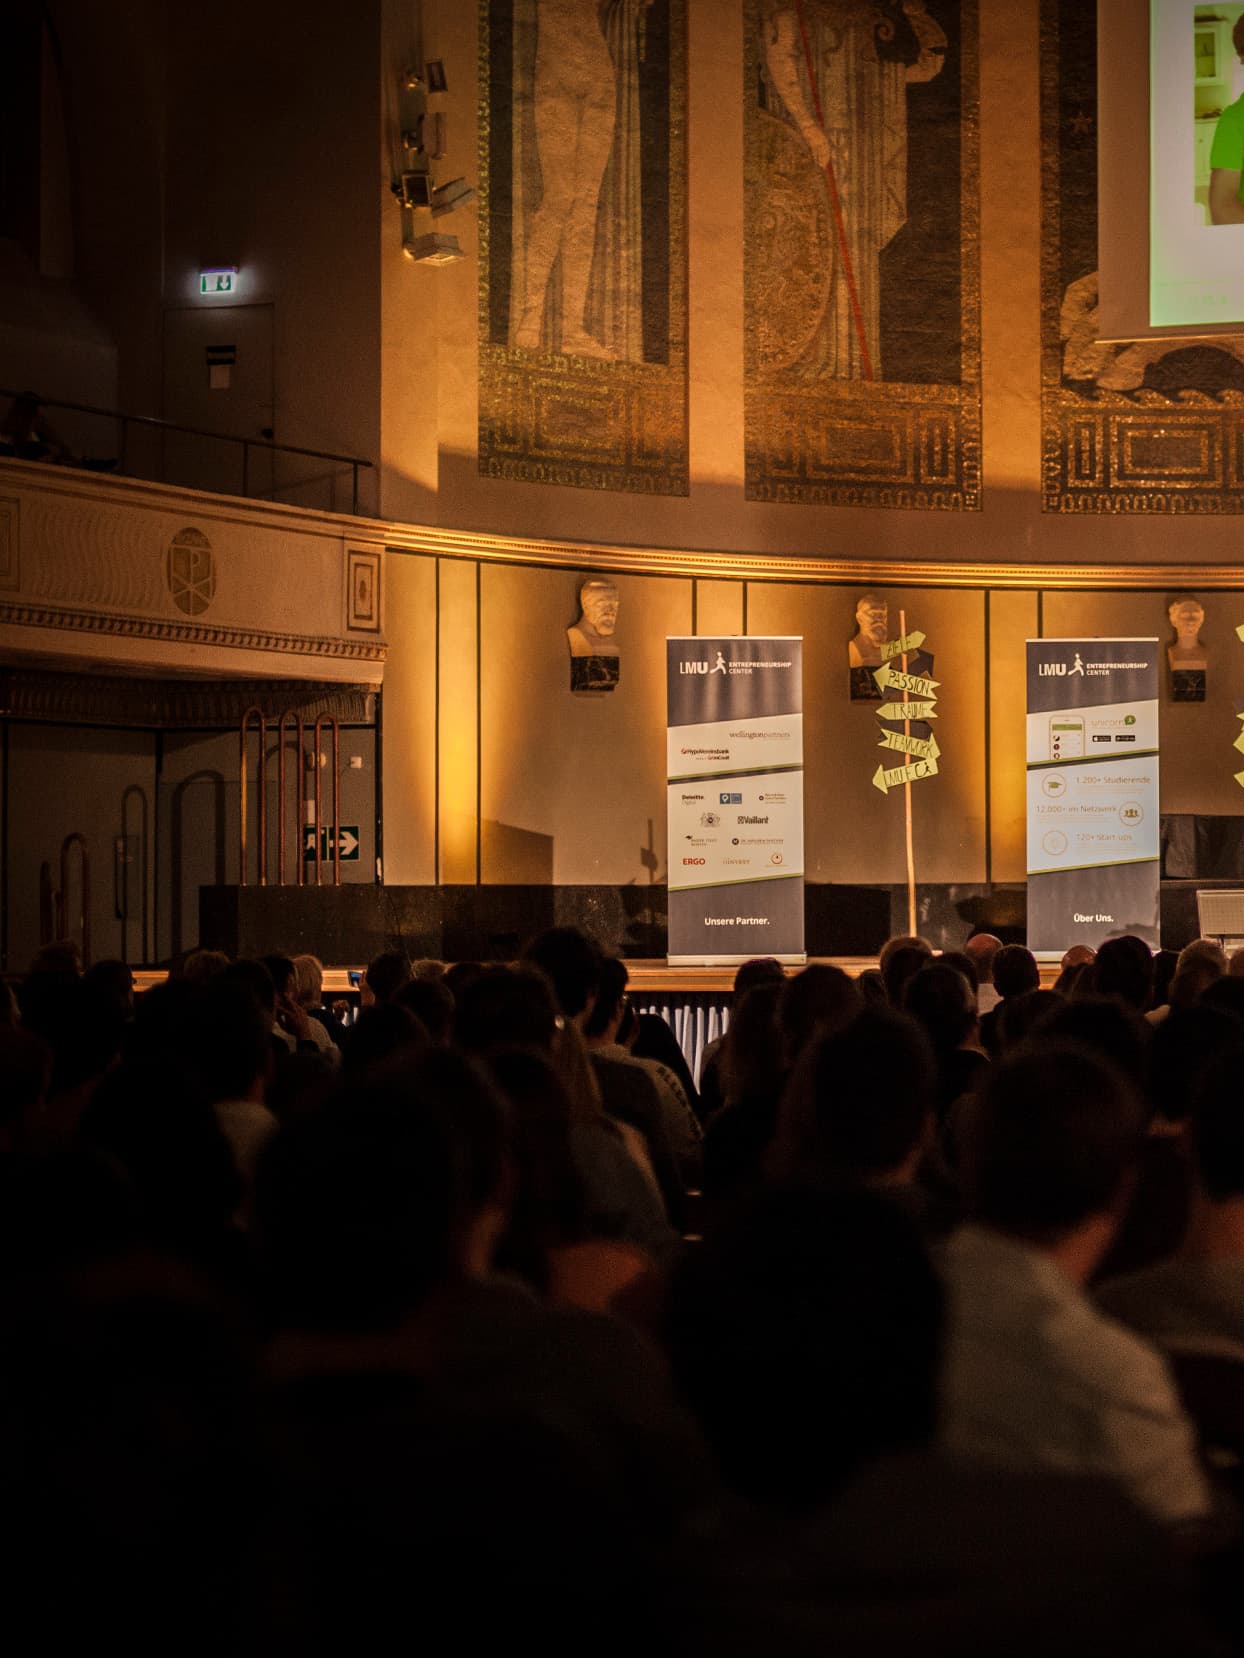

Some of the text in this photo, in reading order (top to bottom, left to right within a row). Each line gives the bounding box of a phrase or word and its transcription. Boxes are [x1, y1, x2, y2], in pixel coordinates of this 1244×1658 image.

[680, 662, 708, 674] LMU
[1039, 663, 1066, 676] LMU
[888, 671, 931, 696] PASSION
[744, 816, 769, 825] Vaillant
[704, 917, 770, 925] Unsere Partner.
[1074, 913, 1114, 922] Über Uns.
